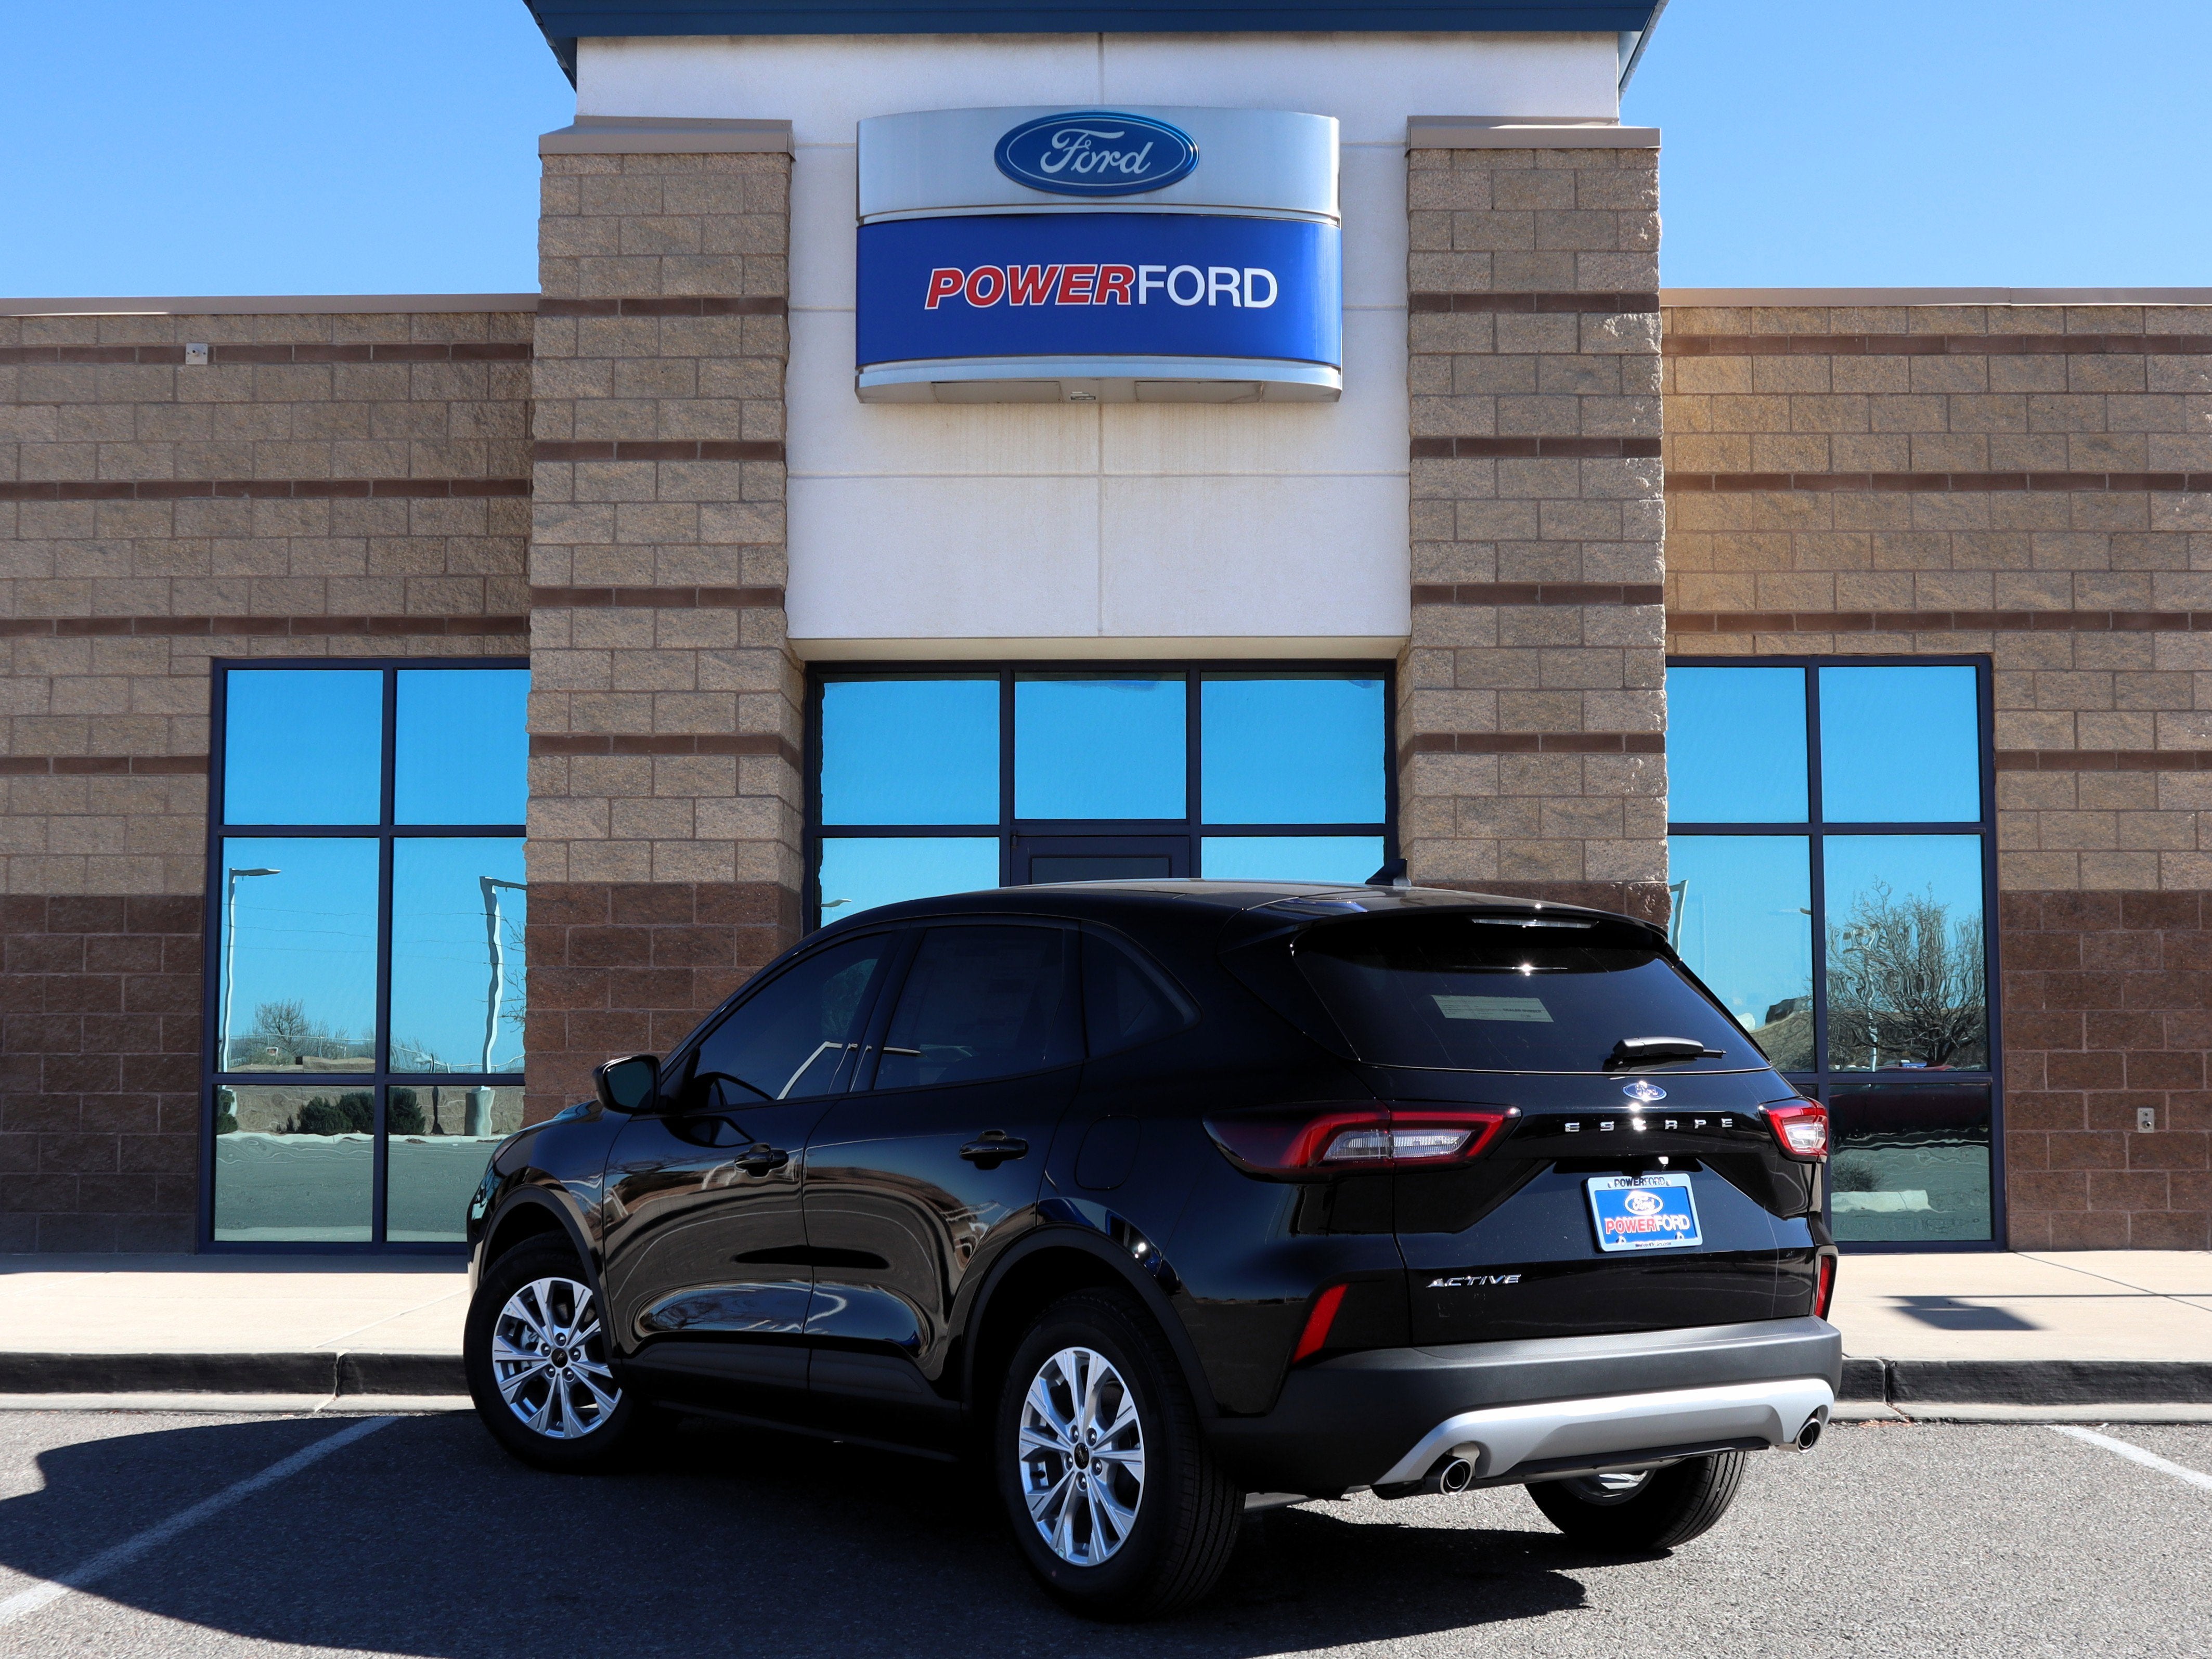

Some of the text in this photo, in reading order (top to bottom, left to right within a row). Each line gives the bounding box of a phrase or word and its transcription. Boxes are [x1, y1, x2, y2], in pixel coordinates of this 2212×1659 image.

[1040, 128, 1154, 174] Ford
[924, 263, 1278, 310] POWERFORD
[1564, 1118, 1733, 1132] ESCAPE
[1614, 1176, 1665, 1187] POWERFORD
[1632, 1196, 1655, 1211] Ford
[1604, 1214, 1690, 1235] POWERFORD
[1426, 1274, 1522, 1288] ACTIVE
